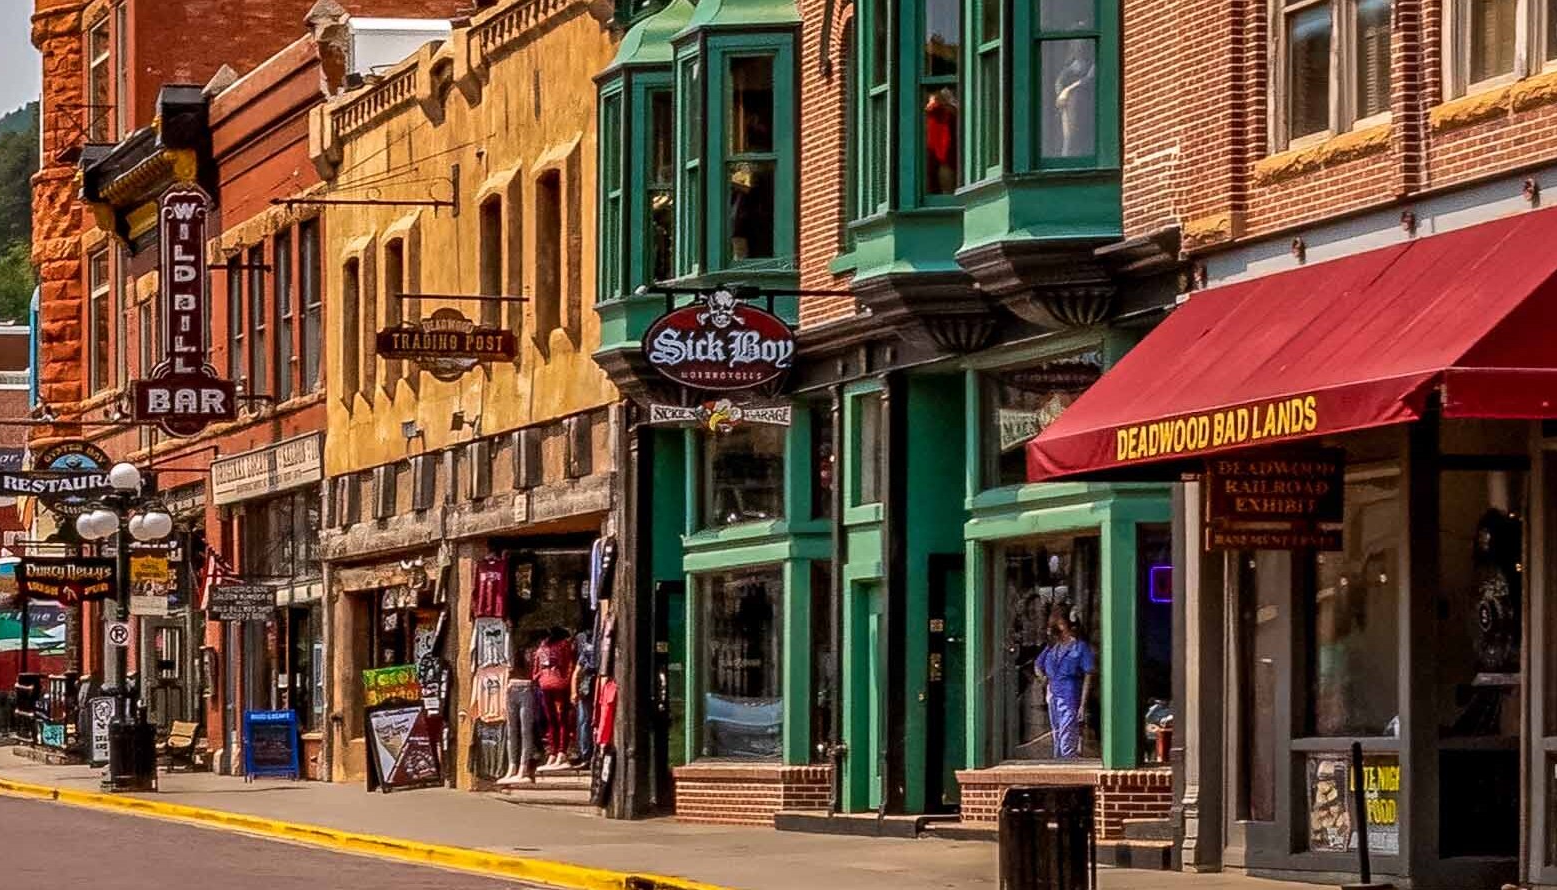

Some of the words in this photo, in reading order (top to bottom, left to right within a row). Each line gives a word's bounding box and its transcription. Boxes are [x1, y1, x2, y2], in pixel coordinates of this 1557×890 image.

[173, 202, 197, 283] WILD
[173, 293, 197, 374] BILL
[391, 333, 458, 350] TRADING
[465, 335, 504, 351] POST
[649, 327, 727, 366] Sick
[727, 329, 794, 368] Boy
[147, 387, 227, 414] BAR
[1116, 415, 1210, 461] DEADWOOD
[1213, 407, 1249, 446] BAD
[1251, 395, 1317, 440] LANDS
[2, 474, 137, 494] RESTAURA
[1225, 479, 1329, 495] RAILROAD
[1237, 498, 1317, 513] EXHIBIT
[1367, 798, 1397, 825] FOOD
